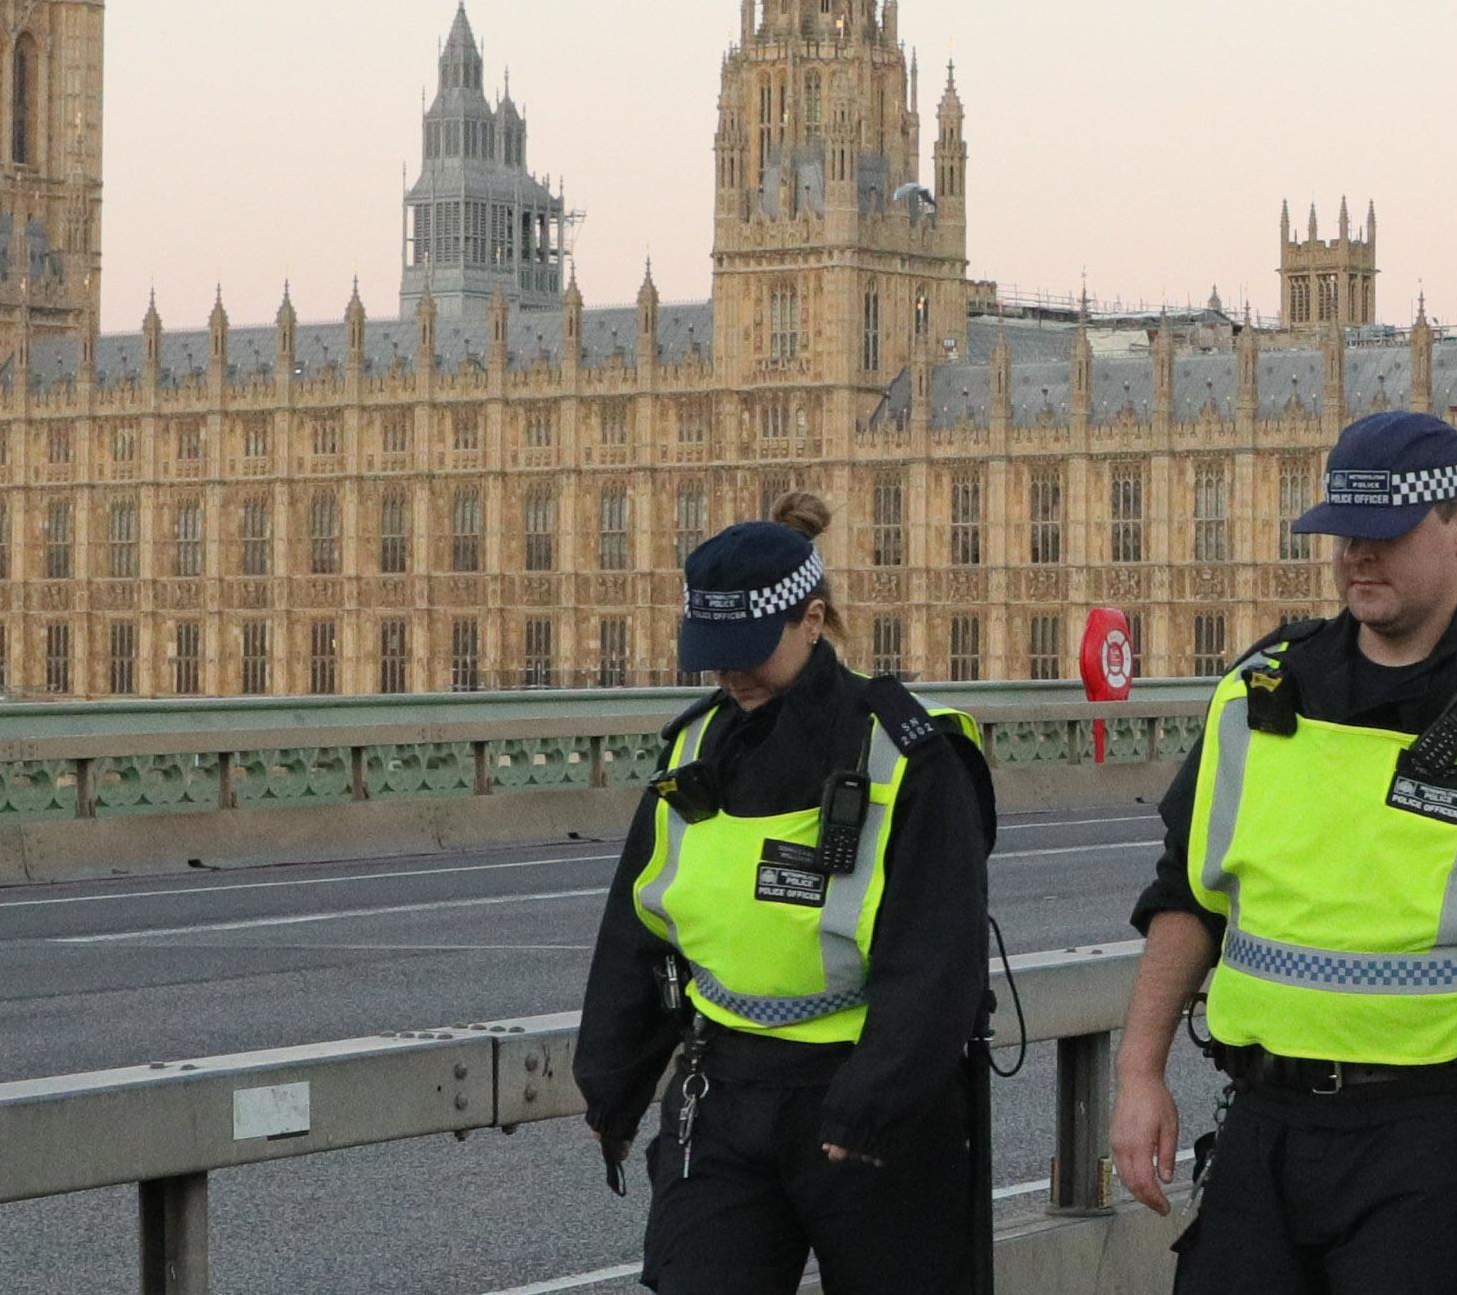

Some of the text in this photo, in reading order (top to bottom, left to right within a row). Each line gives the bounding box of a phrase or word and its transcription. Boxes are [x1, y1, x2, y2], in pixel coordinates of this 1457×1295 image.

[1330, 493, 1390, 504] POLICE OFFICER
[713, 611, 747, 620] OFFICER
[901, 717, 919, 732] SN
[901, 722, 934, 746] 2602
[1391, 794, 1423, 809] POLICE
[1423, 792, 1453, 803] POLICE
[785, 877, 813, 887] POLICE
[758, 886, 821, 901] POLICE OFFICER
